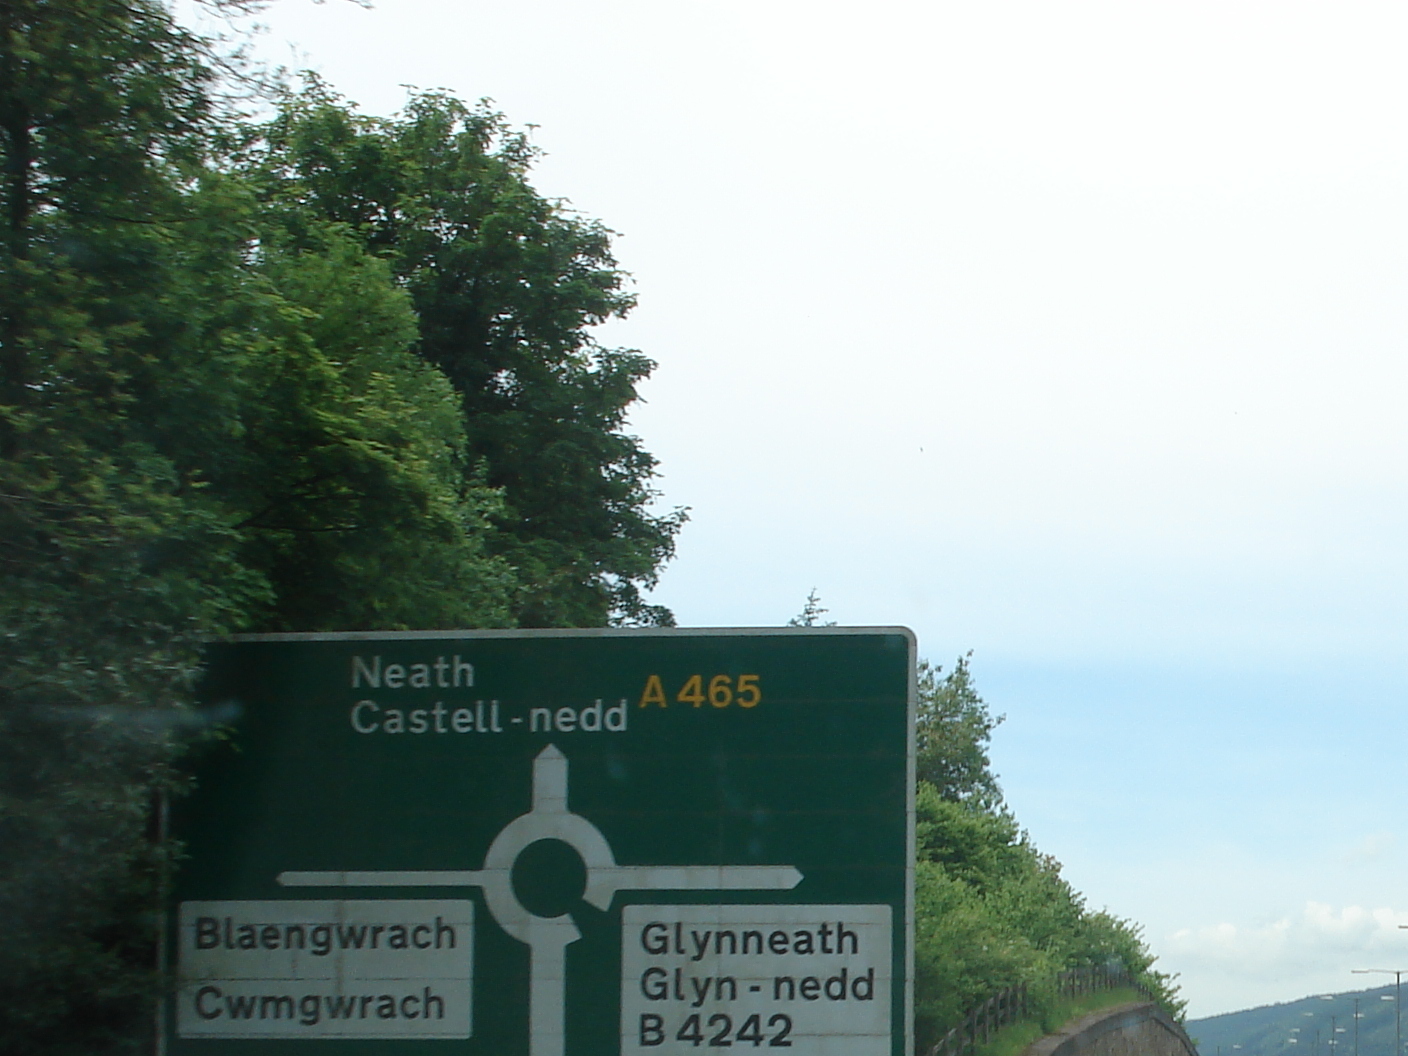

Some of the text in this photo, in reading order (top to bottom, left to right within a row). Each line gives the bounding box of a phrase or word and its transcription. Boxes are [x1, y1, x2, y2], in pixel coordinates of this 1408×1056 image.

[351, 655, 475, 689] Neath
[195, 916, 456, 957] Blaengwrach
[640, 921, 859, 961] Glynneath
[195, 985, 445, 1026] Cwmgwrach
